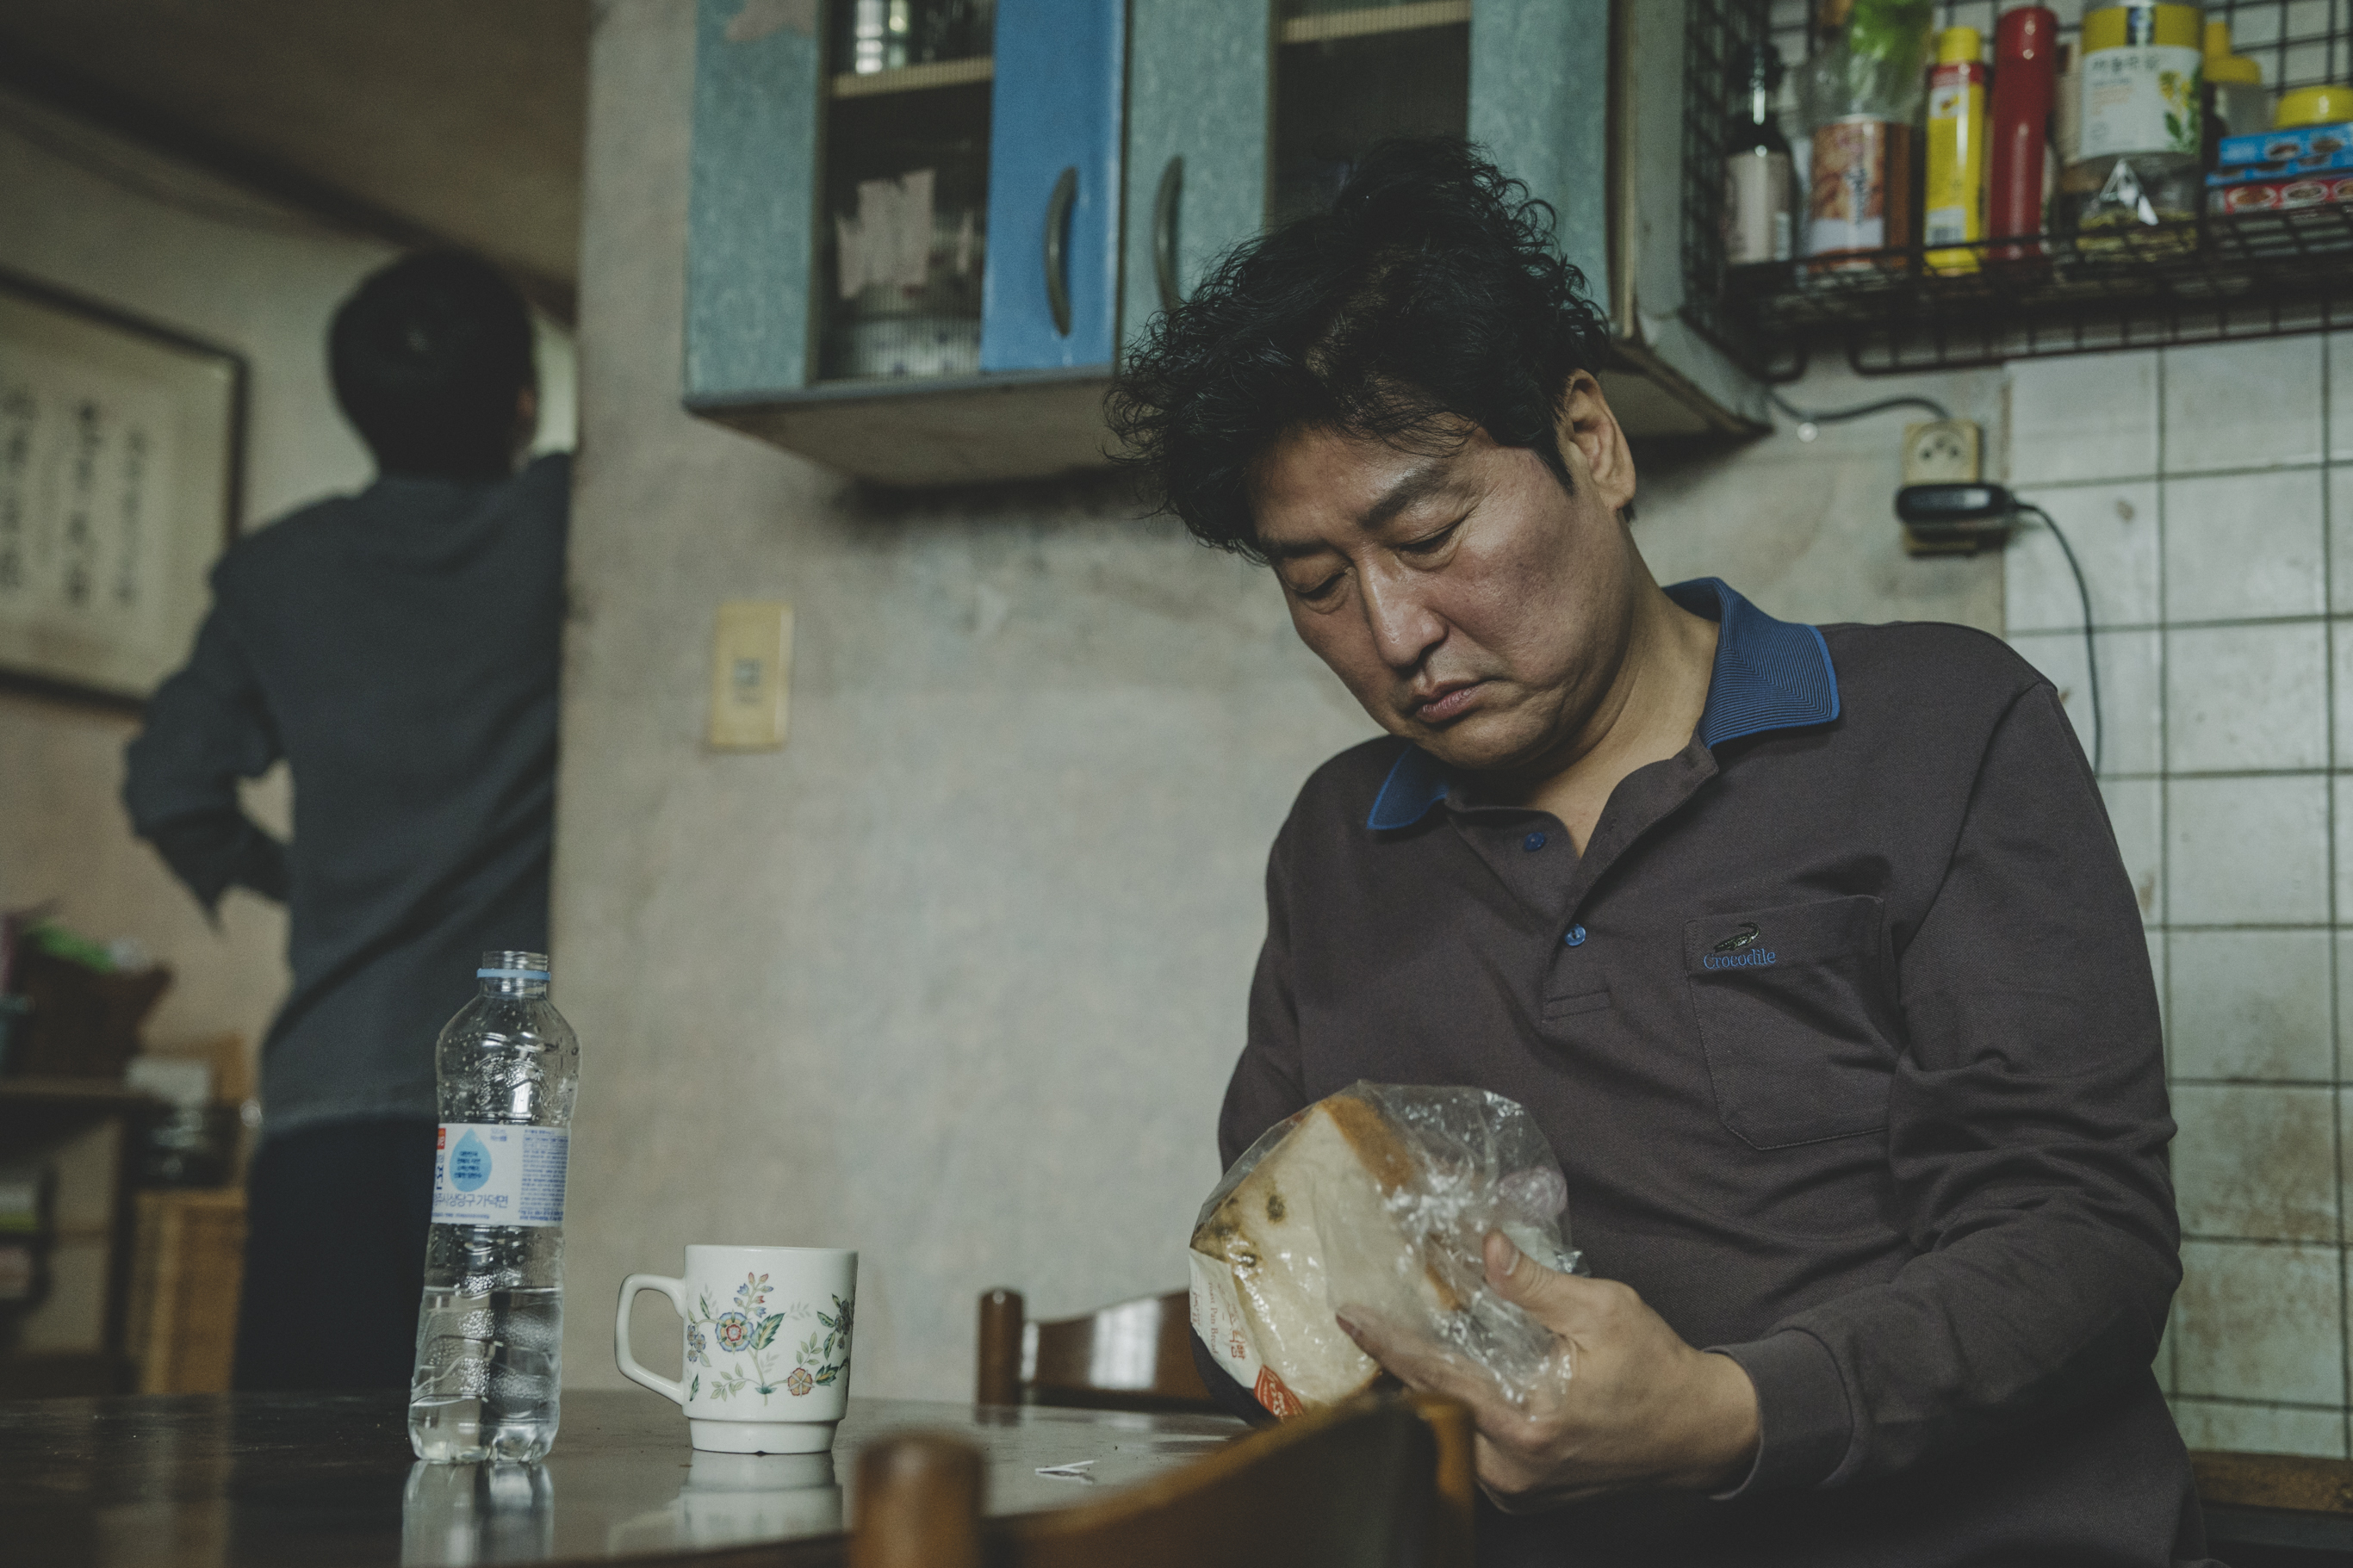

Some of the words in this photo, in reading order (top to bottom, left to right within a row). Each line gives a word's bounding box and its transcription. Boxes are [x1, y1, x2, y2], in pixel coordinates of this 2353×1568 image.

[1704, 948, 1776, 969] Crocodile
[476, 1193, 508, 1208] 가덕면
[1211, 1328, 1220, 1354] Bread
